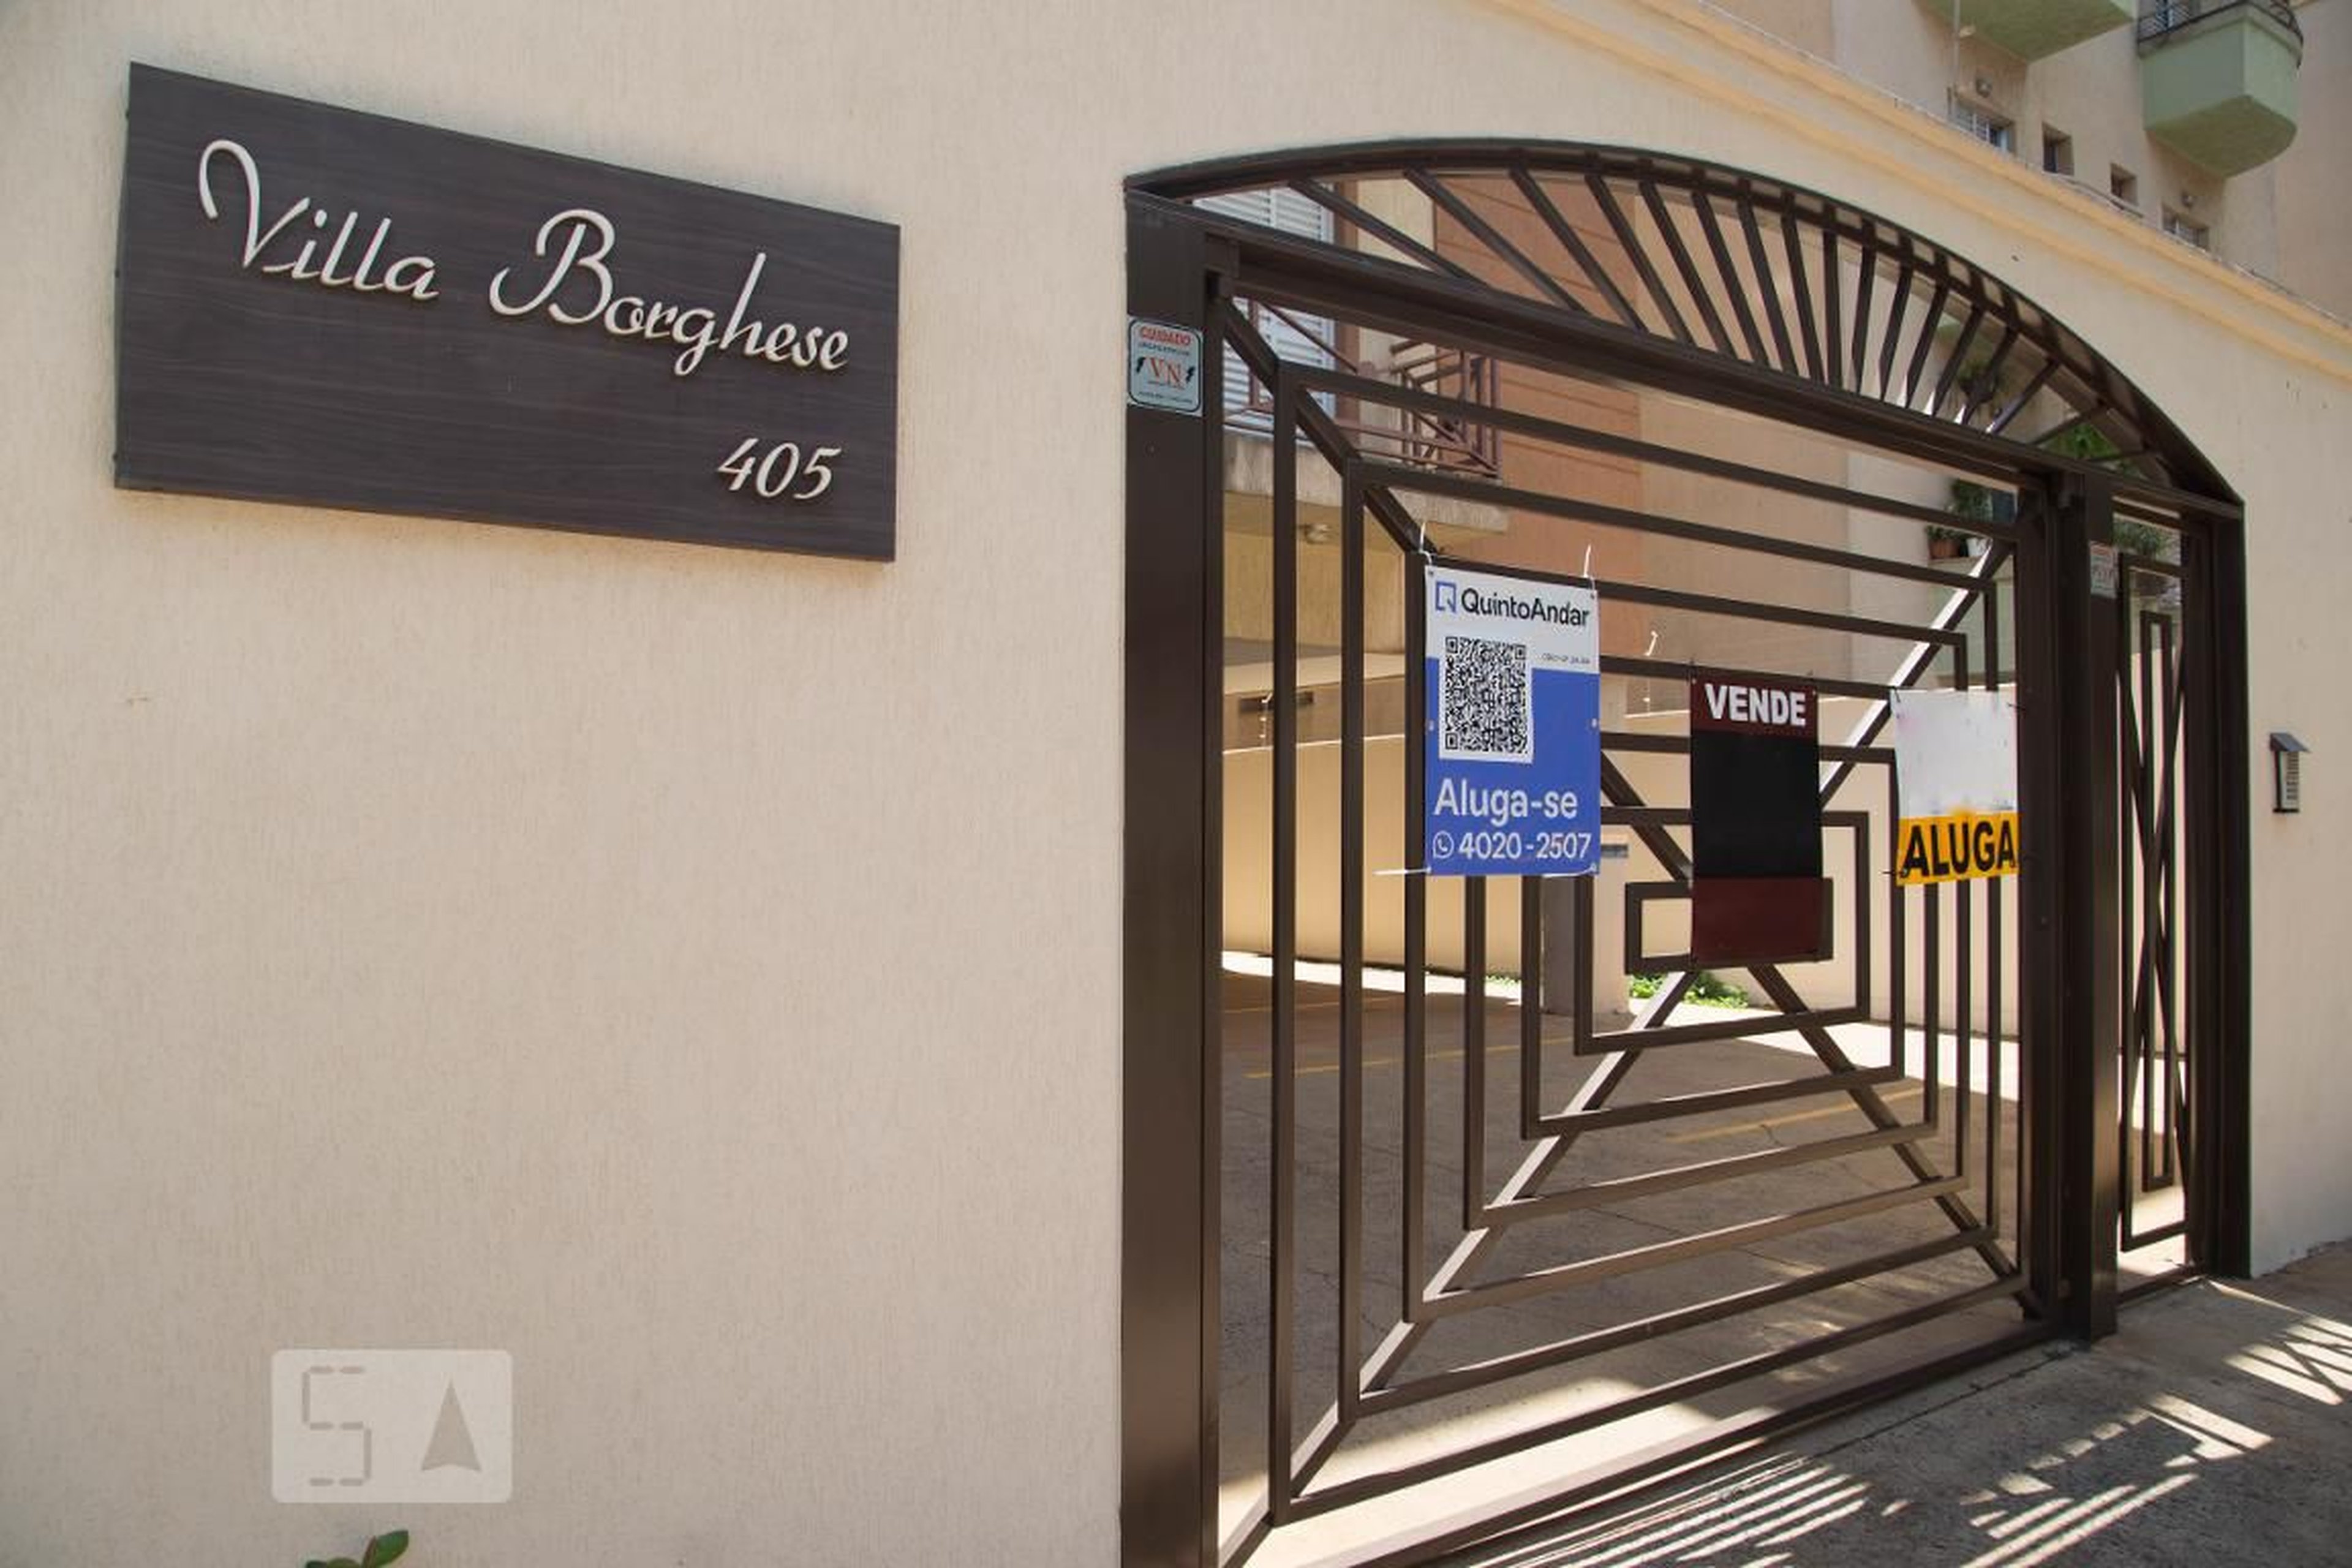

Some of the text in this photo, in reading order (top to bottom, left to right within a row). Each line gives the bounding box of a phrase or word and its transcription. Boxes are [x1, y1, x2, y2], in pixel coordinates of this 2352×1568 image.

[198, 139, 850, 376] Villa Borghese
[717, 437, 842, 499] 405
[1461, 587, 1591, 626] QuintoAndar
[1705, 683, 1806, 727] VENDE
[1434, 778, 1578, 827] Aluga-se
[1899, 820, 2016, 878] ALUGA
